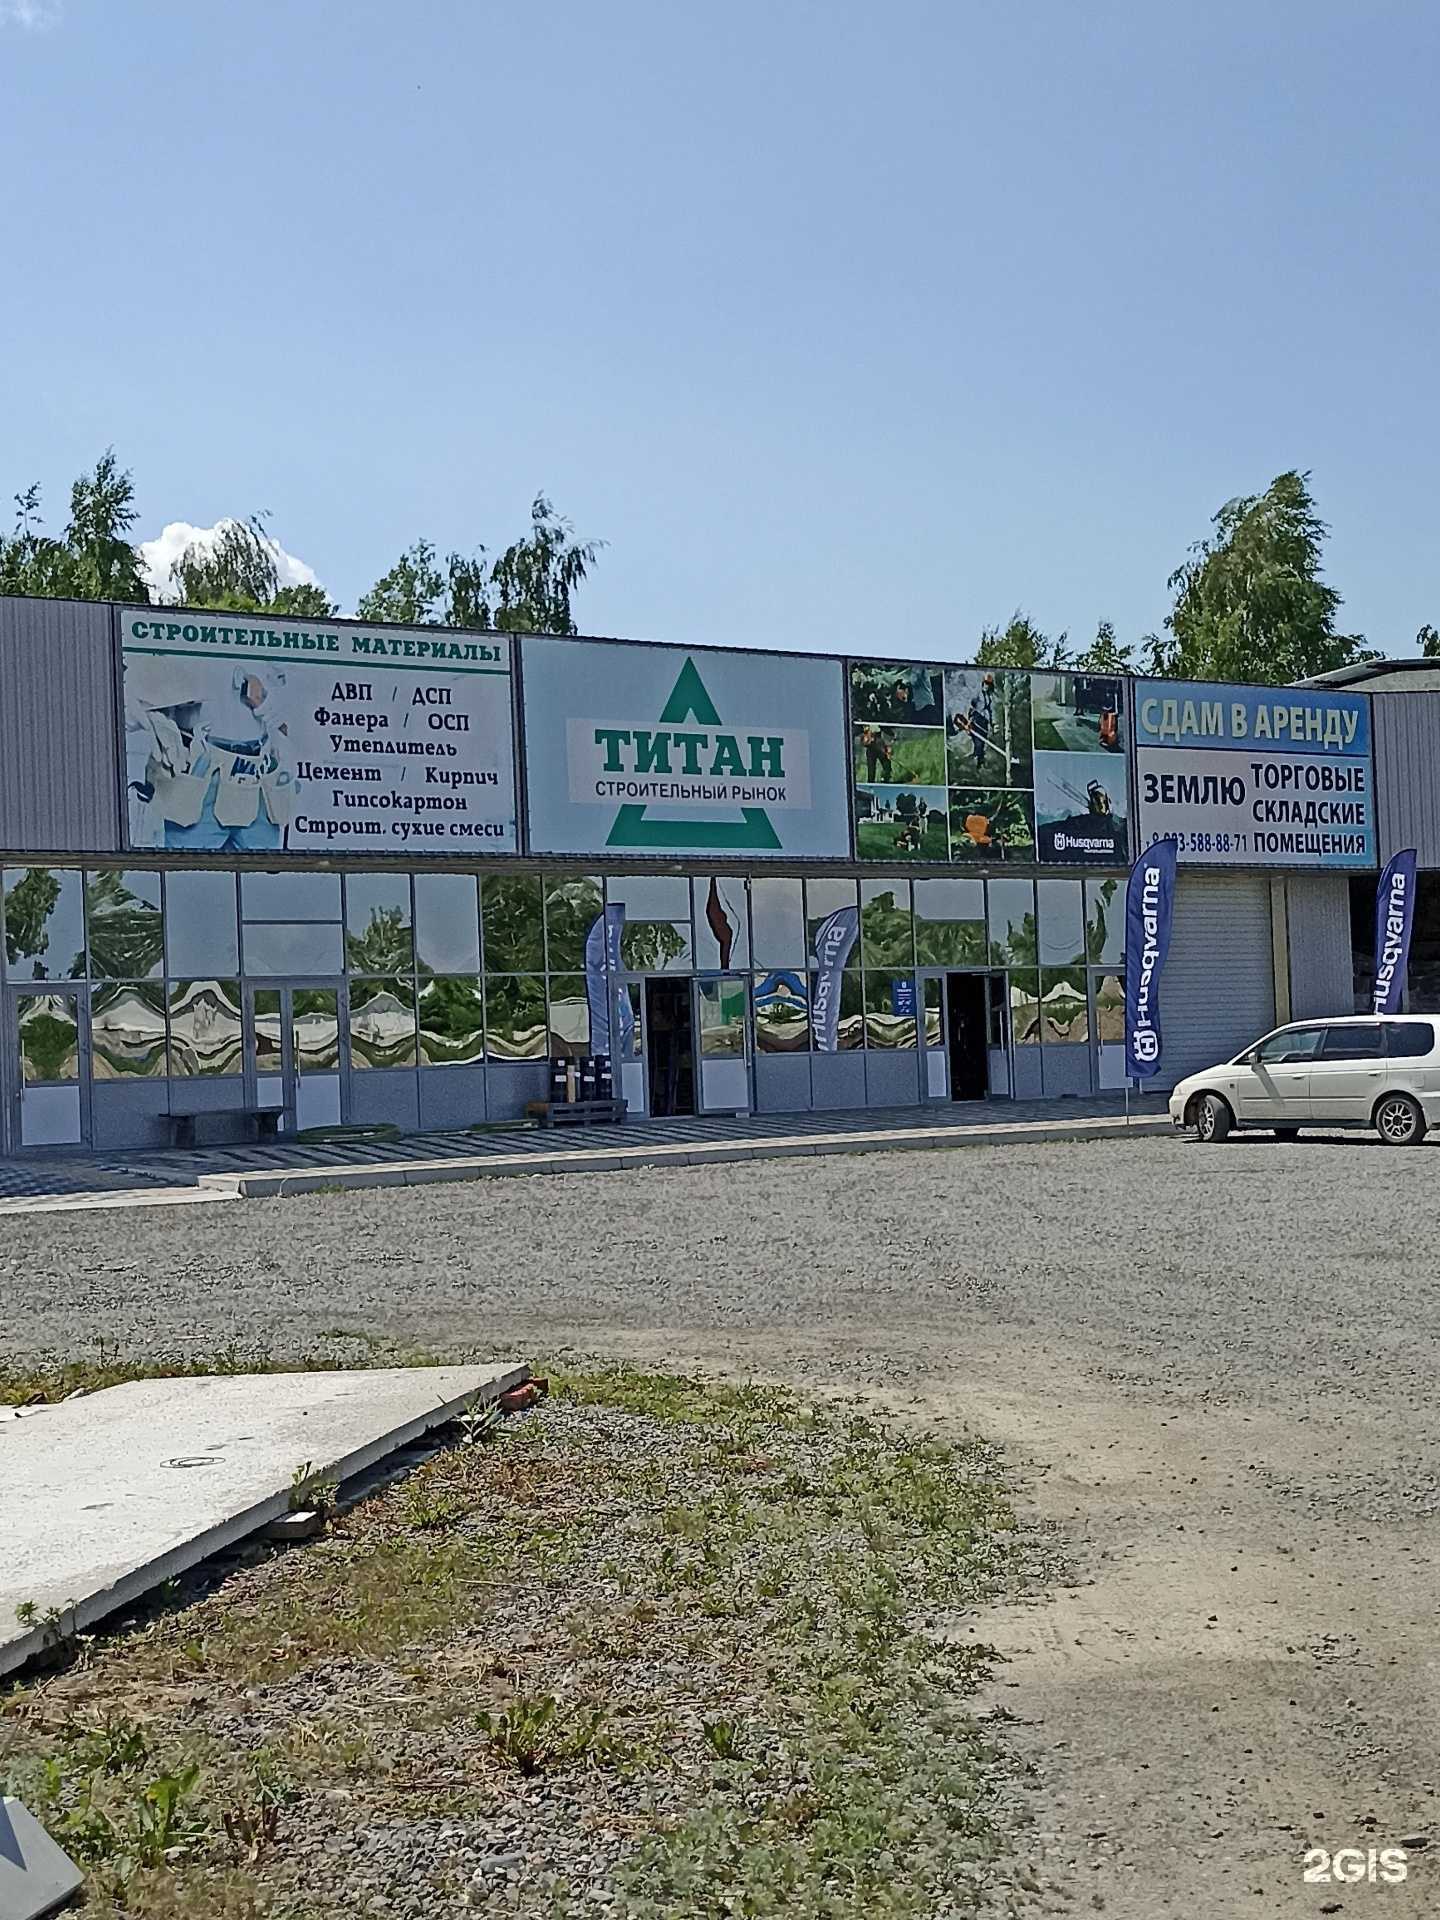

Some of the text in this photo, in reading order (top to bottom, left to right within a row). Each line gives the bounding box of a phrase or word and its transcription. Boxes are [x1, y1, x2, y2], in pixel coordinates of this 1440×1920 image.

[131, 621, 502, 662] СТРОИТЕЛЬНЫЕ МАТЕРИАЛЫ
[331, 682, 373, 702] ДВП
[411, 687, 452, 706] ДСП
[314, 707, 389, 732] Фанера
[428, 713, 470, 731] ОСП
[1141, 698, 1359, 750] СДАМ В АРЕНДУ
[329, 735, 457, 757] Утеплитель
[594, 729, 786, 778] ТИТАН
[297, 762, 382, 782] Цемент
[425, 767, 499, 789] Кирпич
[1250, 763, 1365, 793] ТОРГОВЫЕ
[332, 790, 468, 815] Гипсокартон
[595, 781, 787, 801] СТРОИТЕЛЬНЫЙ РЫНОК
[1143, 773, 1246, 806] ЗЕМЛЮ
[1252, 799, 1365, 829] СКЛАДСКИЕ
[295, 816, 505, 840] Строит. сухие смеси
[1066, 836, 1114, 850] Husqvarna
[1253, 832, 1365, 856] ПОМЕЩЕНИЯ
[1137, 866, 1161, 1028] Husqvarna
